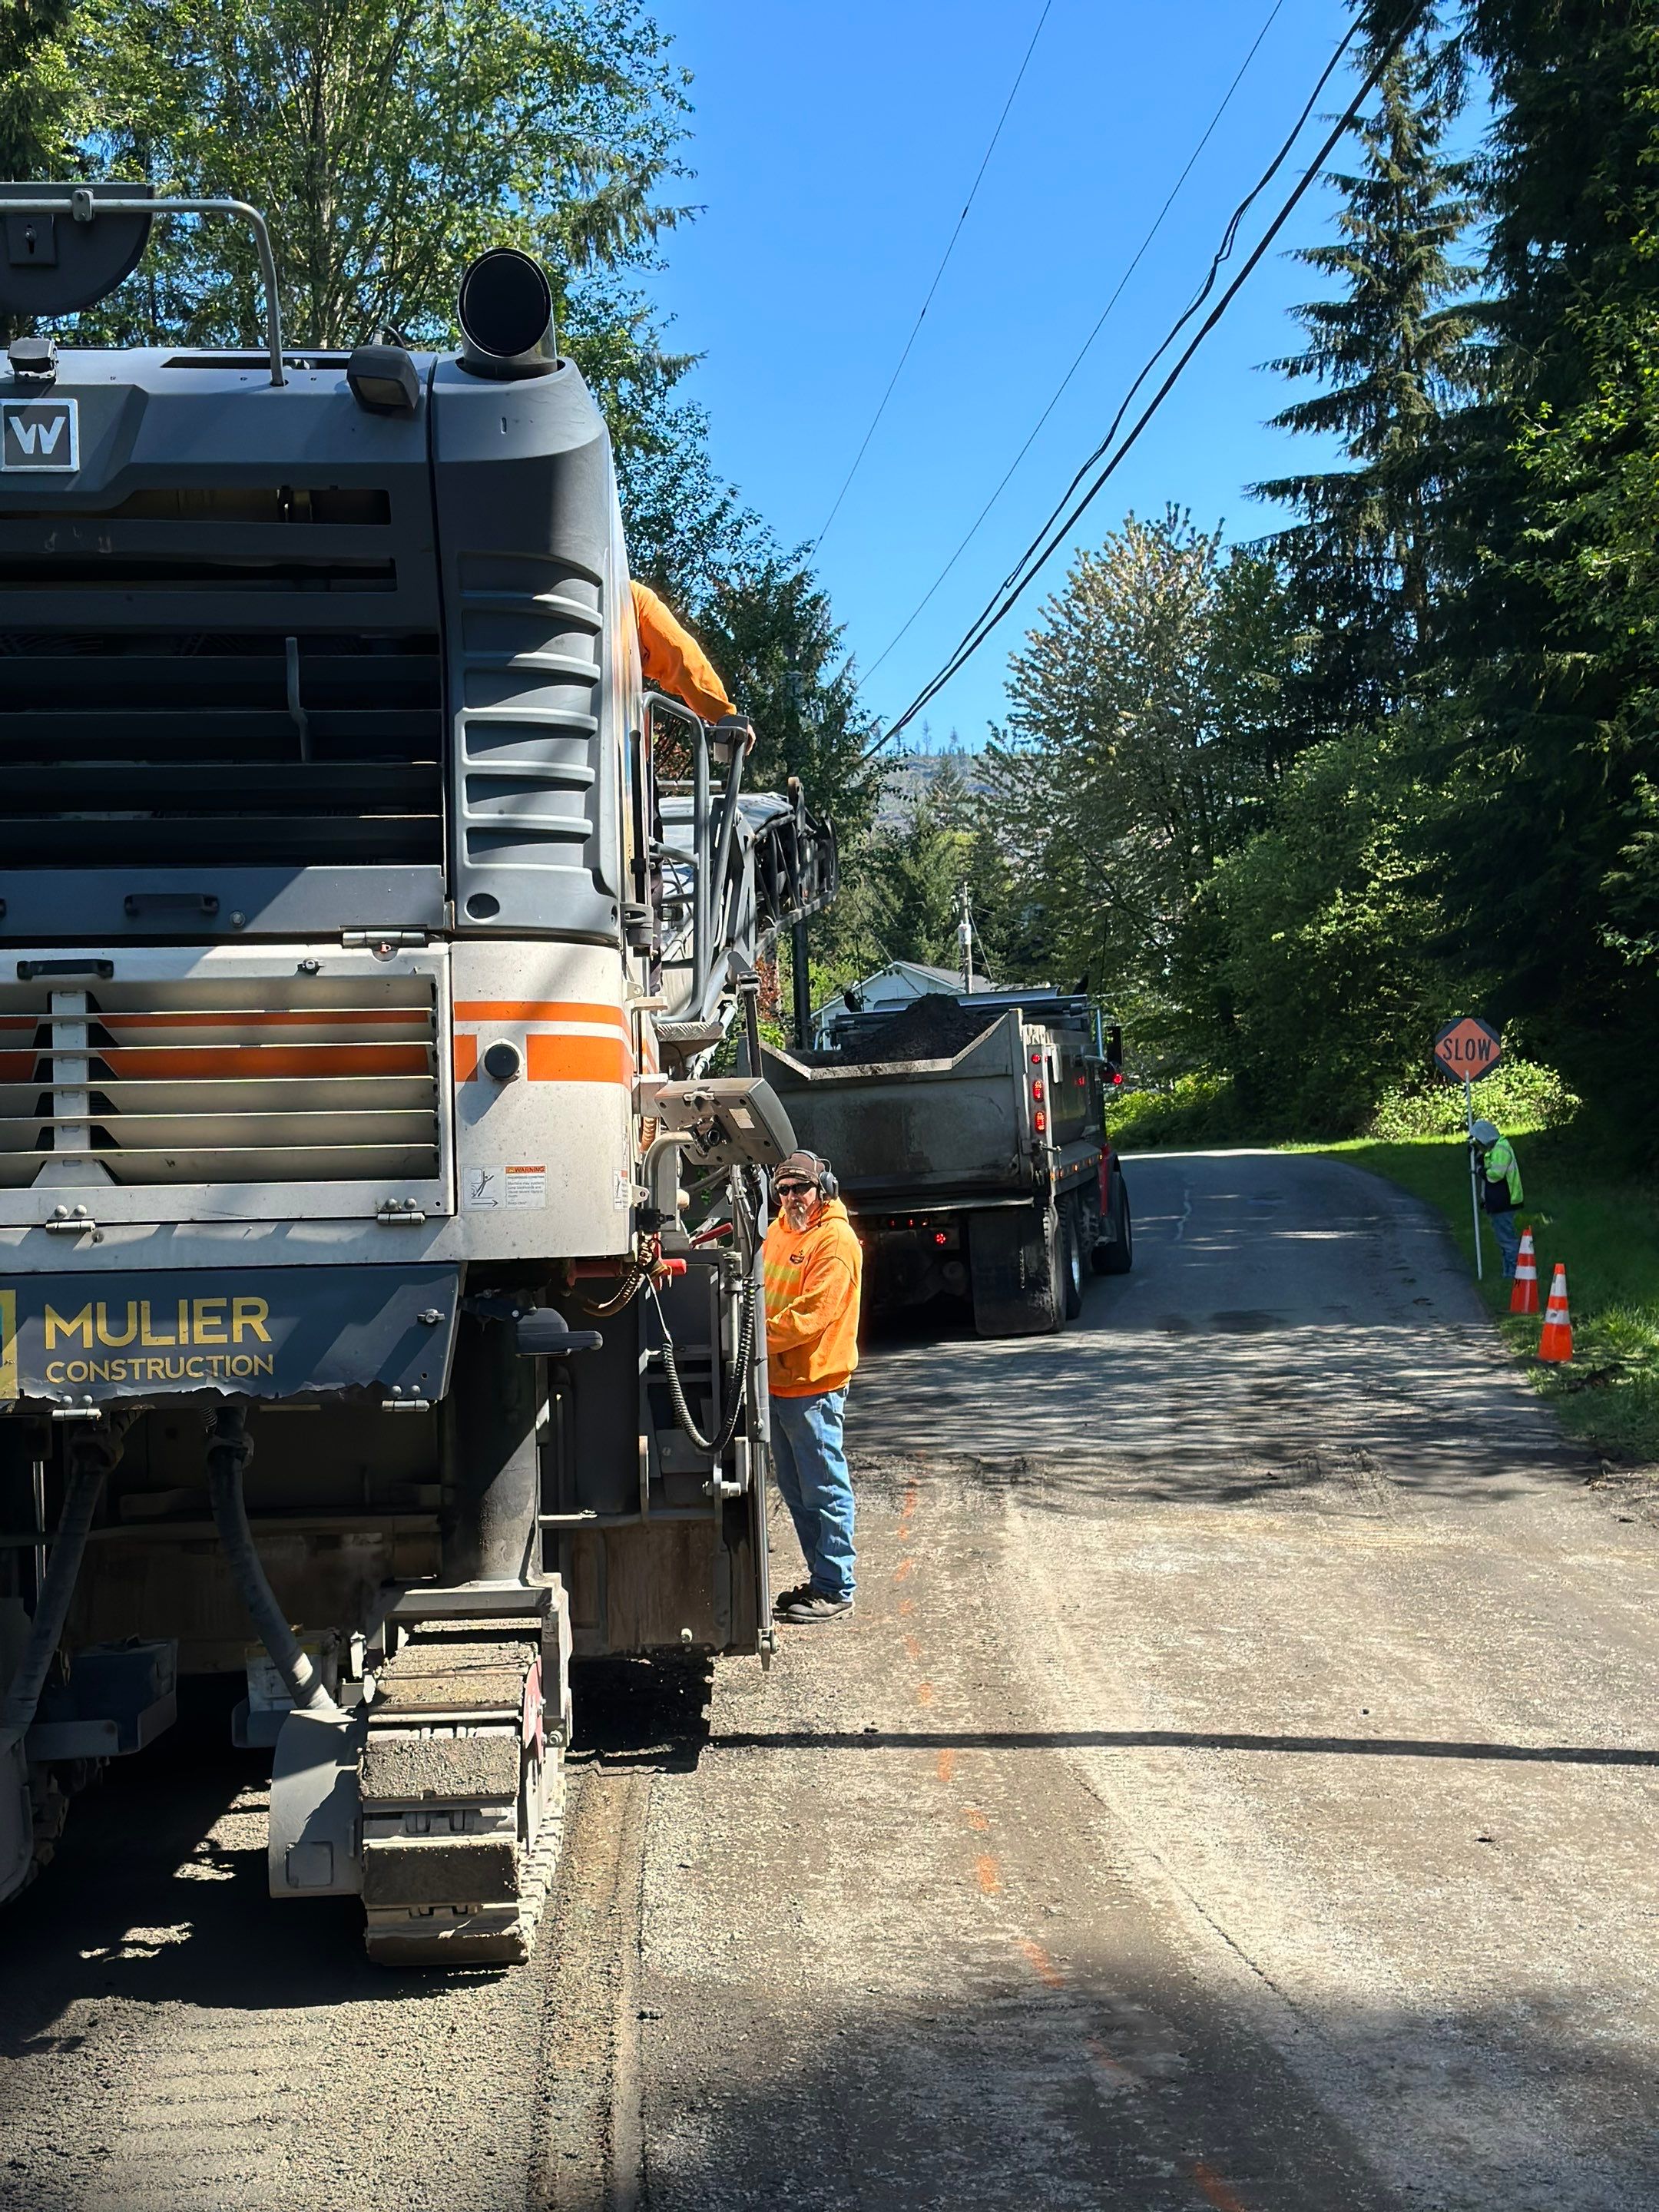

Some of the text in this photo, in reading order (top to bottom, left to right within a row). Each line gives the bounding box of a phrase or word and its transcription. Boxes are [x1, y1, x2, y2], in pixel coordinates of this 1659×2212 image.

[8, 416, 67, 455] W
[1443, 1038, 1492, 1061] SLOW
[45, 1296, 273, 1349] MULIER
[46, 1354, 273, 1383] CONSTRUCTION
